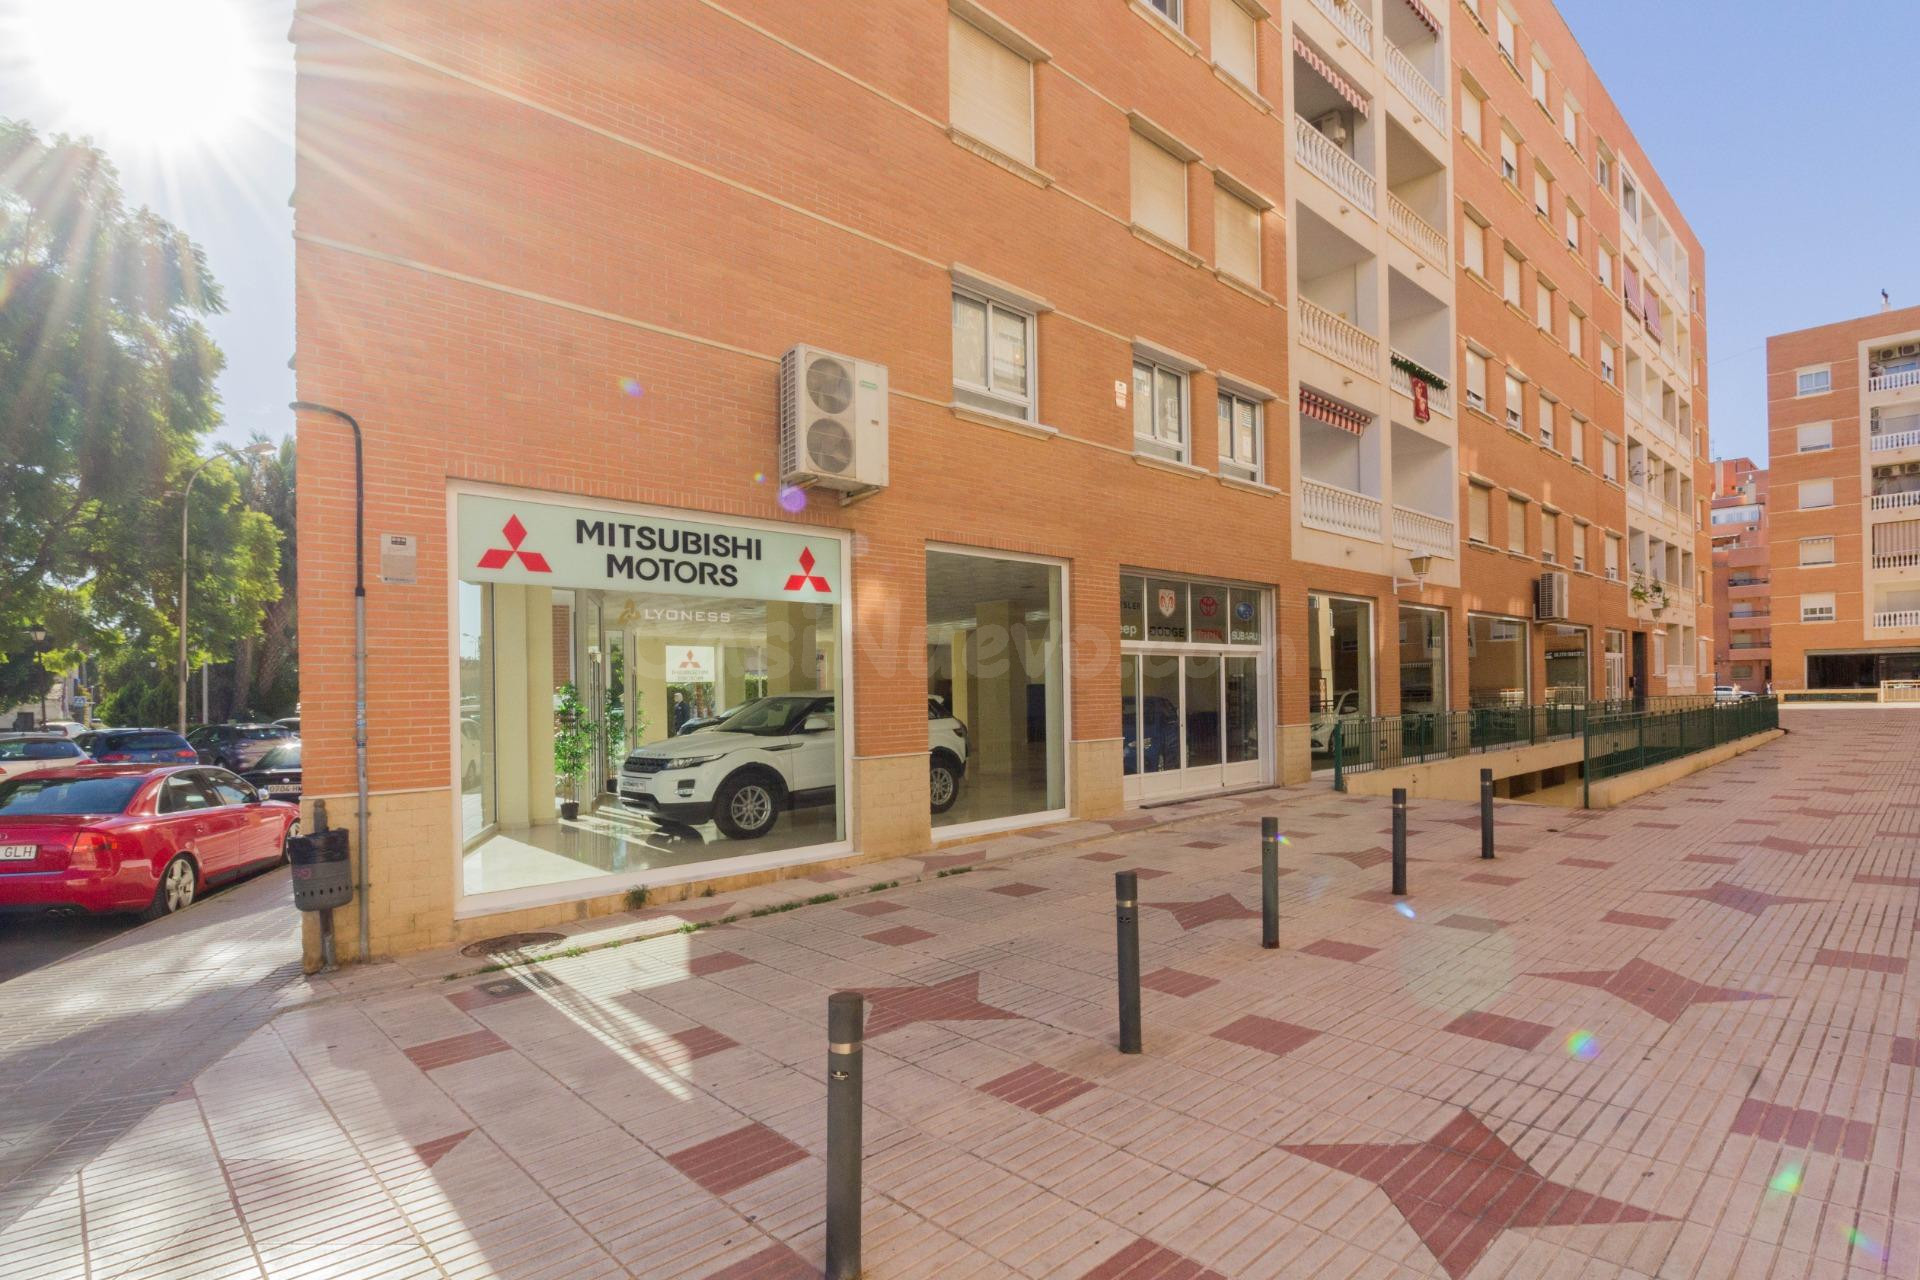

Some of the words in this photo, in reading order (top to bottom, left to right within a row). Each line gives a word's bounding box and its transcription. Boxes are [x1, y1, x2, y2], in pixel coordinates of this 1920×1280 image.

[576, 519, 762, 560] MITSUBISHI
[606, 553, 738, 587] MOTORS
[644, 608, 731, 622] LYONESS
[1150, 626, 1185, 637] DODGE
[1231, 631, 1258, 641] SUBARU
[4, 846, 33, 858] GLH
